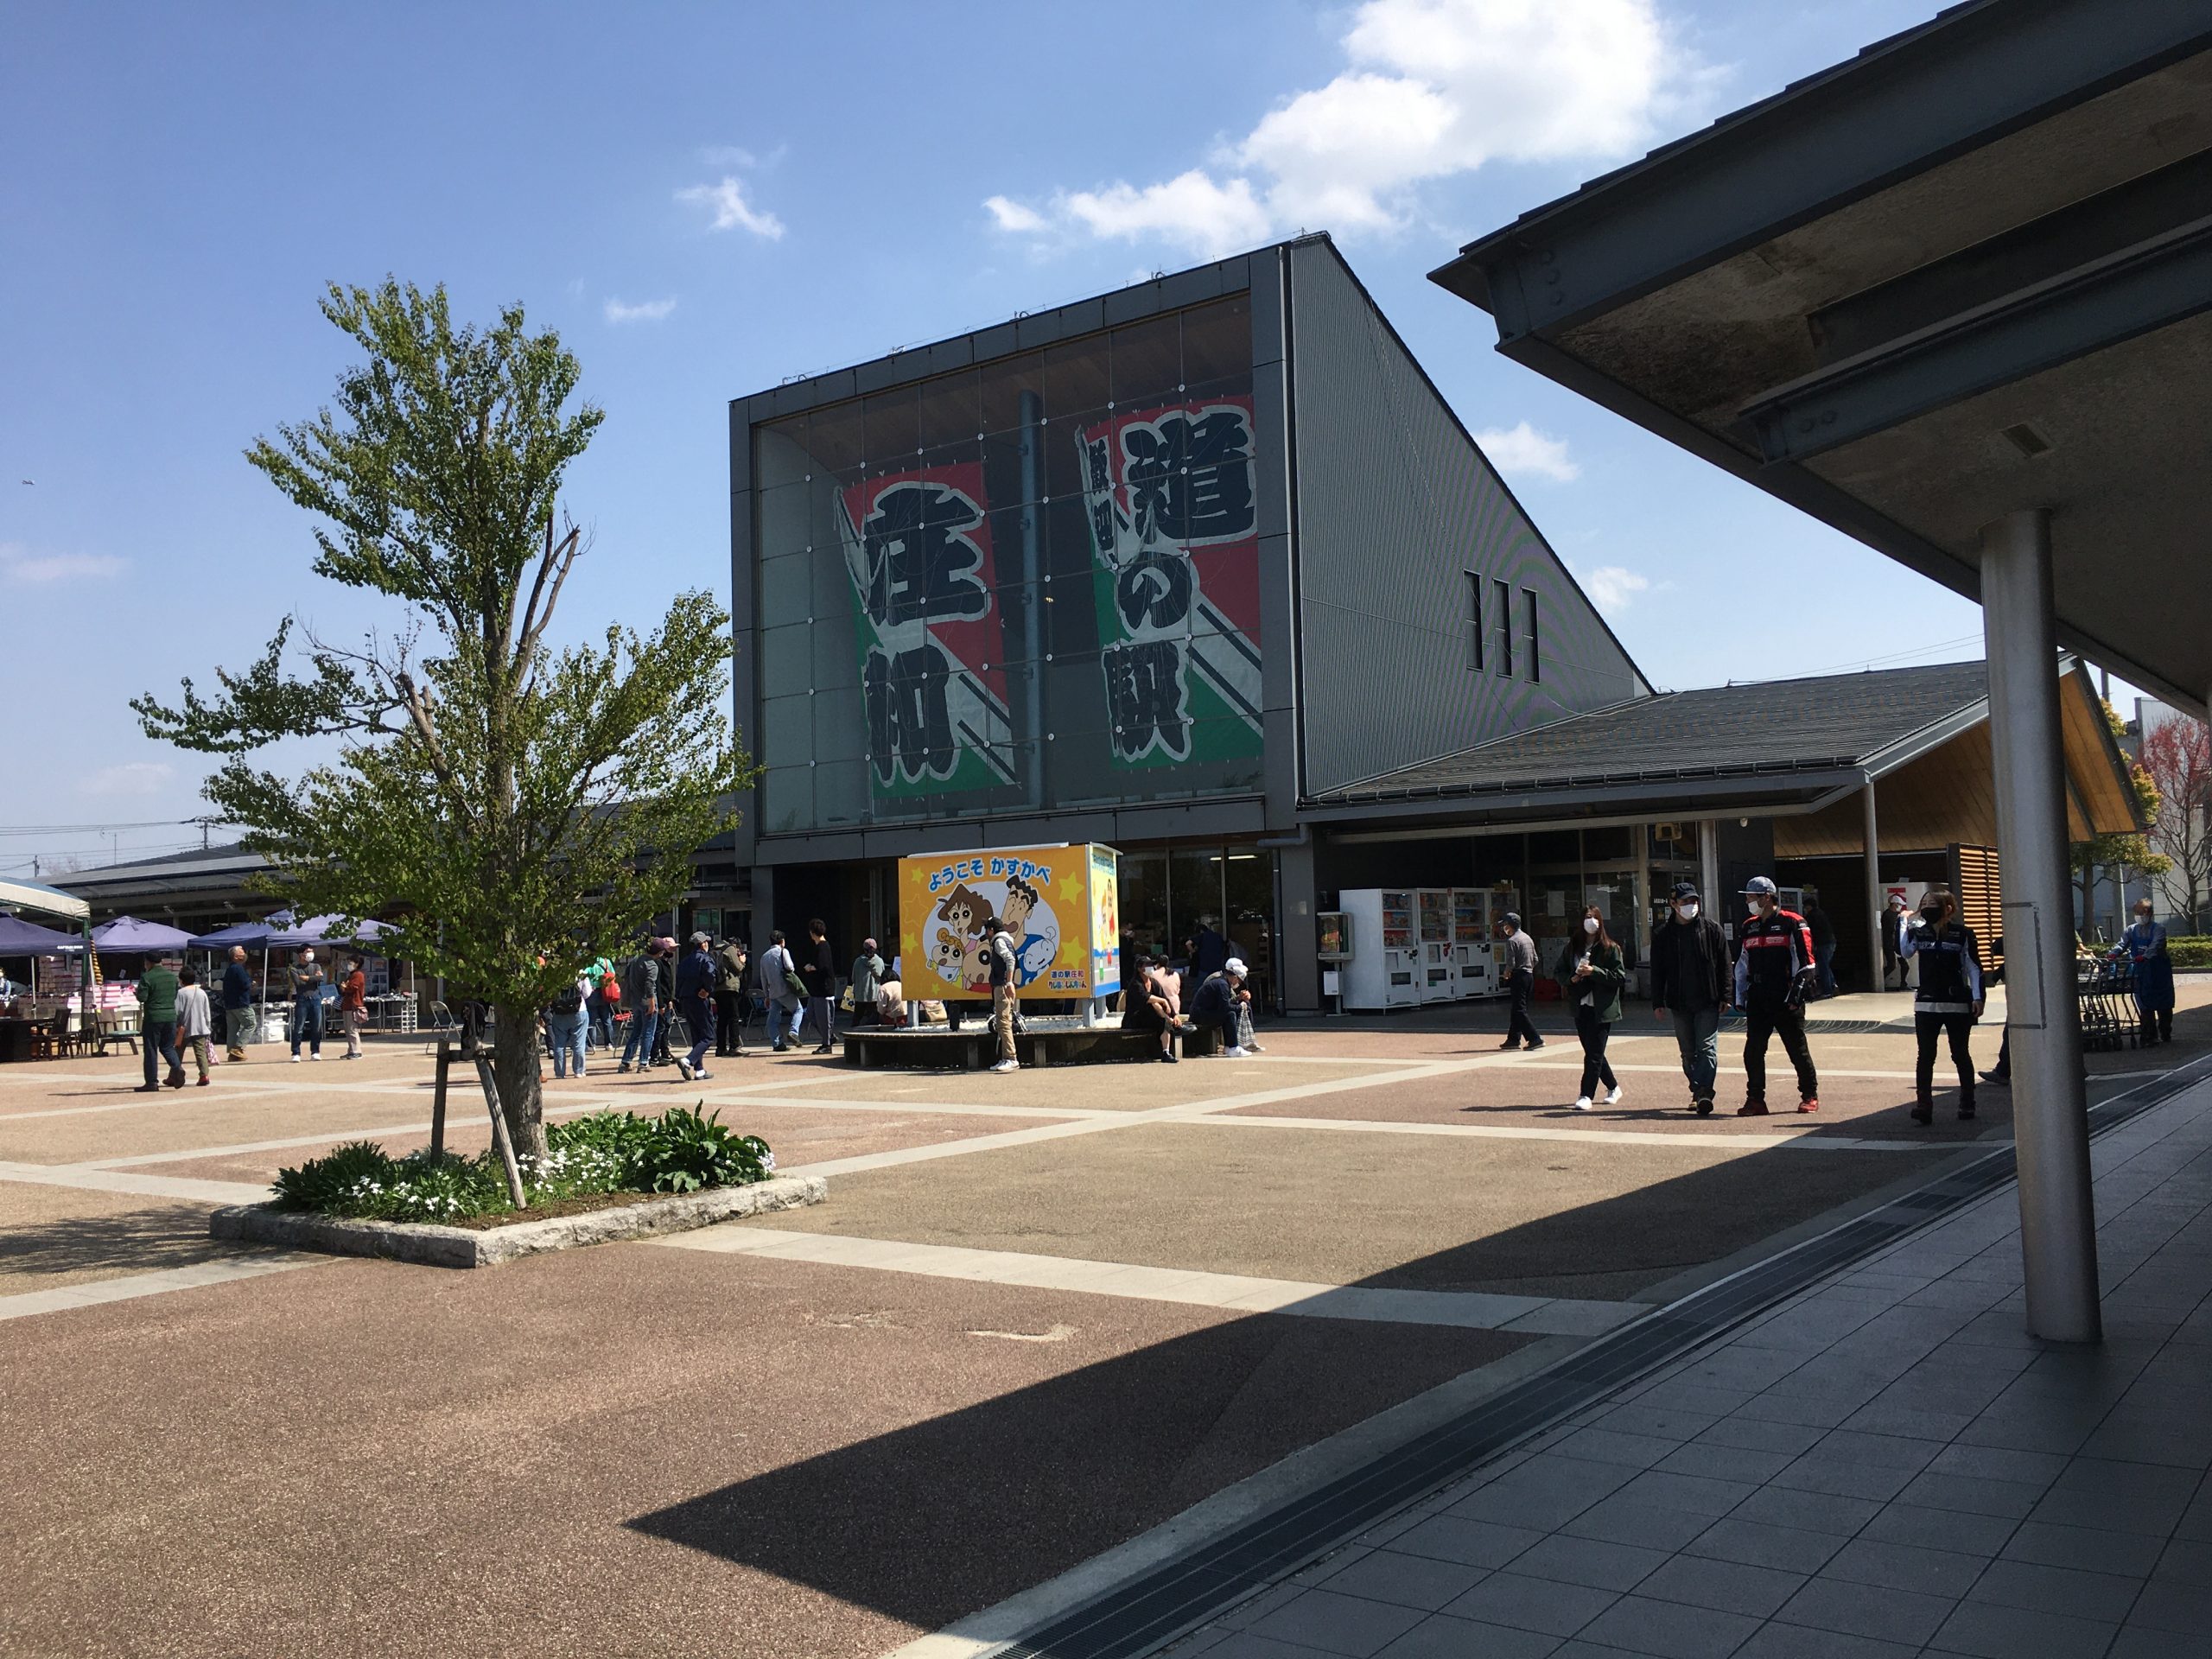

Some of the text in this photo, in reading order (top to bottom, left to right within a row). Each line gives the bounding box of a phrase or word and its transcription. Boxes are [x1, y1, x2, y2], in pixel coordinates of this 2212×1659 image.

[863, 484, 990, 785] 庄和
[1102, 407, 1257, 759] 道の駅
[929, 857, 1051, 892] ようこそ かすかべ
[1051, 969, 1084, 979] 道の駅庄和
